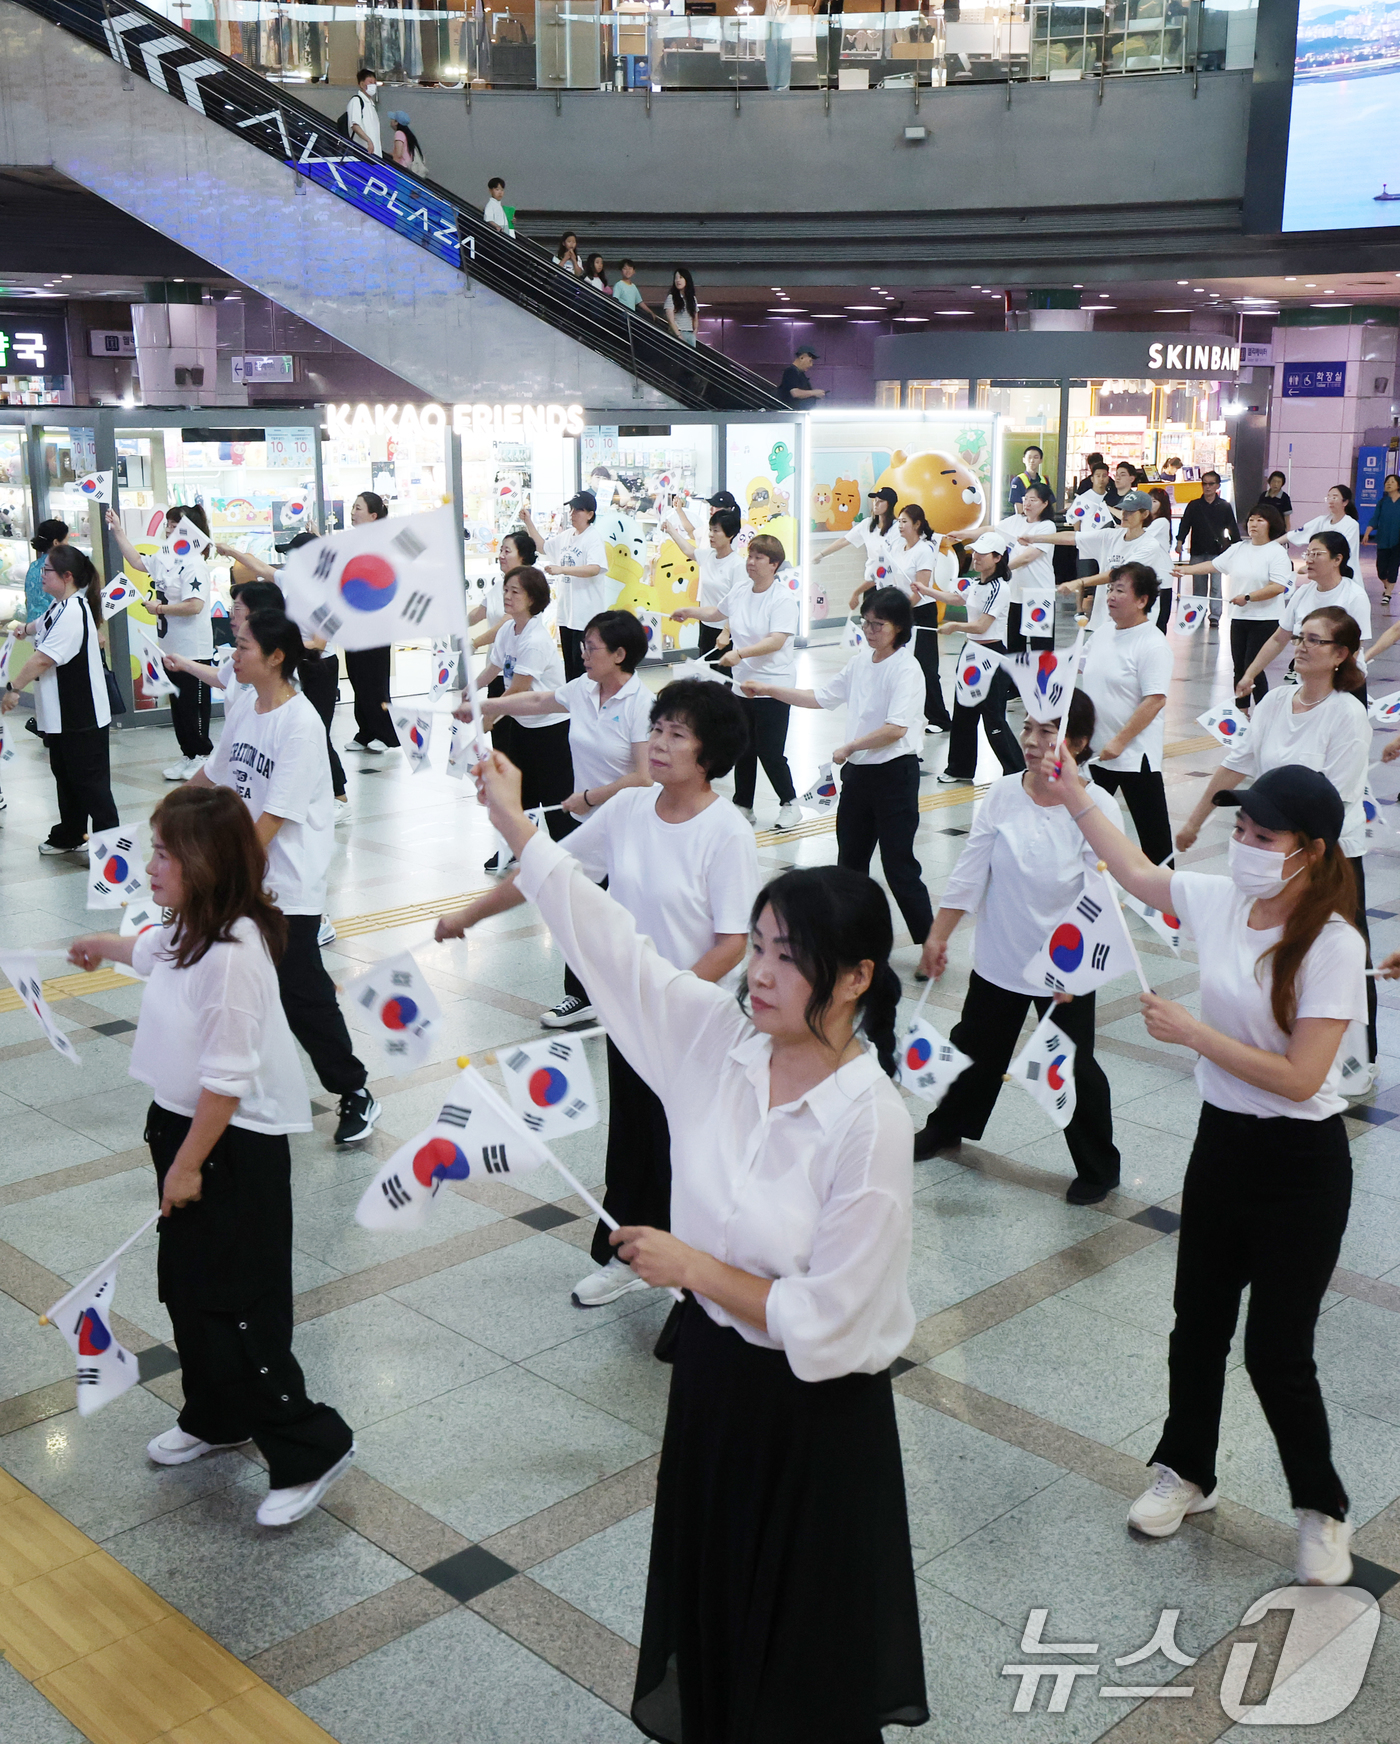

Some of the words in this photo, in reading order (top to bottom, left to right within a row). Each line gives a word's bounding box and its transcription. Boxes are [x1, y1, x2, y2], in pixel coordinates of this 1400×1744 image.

[363, 176, 476, 259] PLAZA
[0, 331, 47, 368] 국
[326, 403, 447, 435] KAKAO
[453, 403, 585, 435] FRIENDS
